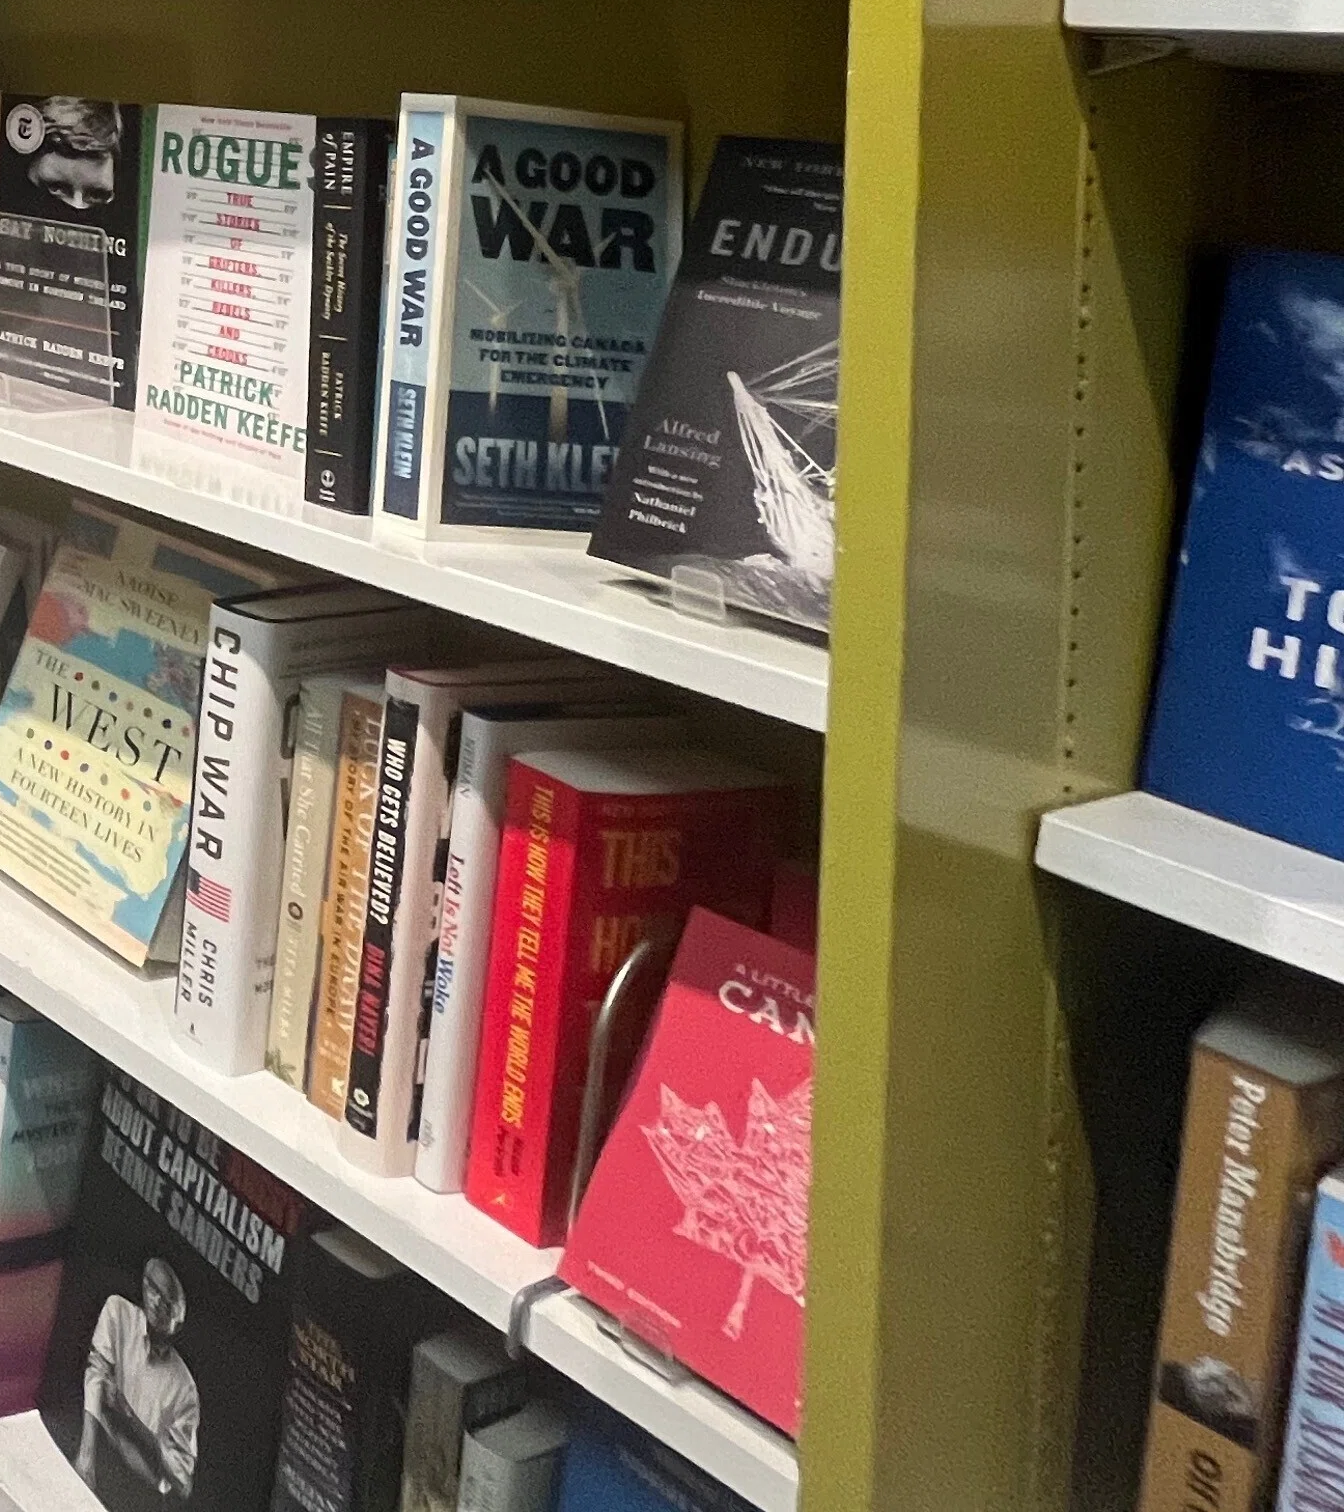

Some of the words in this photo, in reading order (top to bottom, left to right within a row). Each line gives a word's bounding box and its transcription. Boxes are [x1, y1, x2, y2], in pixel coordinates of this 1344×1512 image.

[473, 144, 501, 187] A
[515, 148, 656, 199] GOOD
[472, 193, 658, 273] WAR
[146, 384, 228, 430] RADDEN
[236, 412, 306, 453] KEEFE
[178, 360, 275, 406] PATRICK
[207, 625, 242, 743] CHIP
[45, 683, 183, 782] WEST
[383, 737, 406, 782] WHO
[195, 754, 231, 863] WAR
[377, 784, 401, 830] GETS
[366, 832, 395, 926] BELIEVED?
[179, 921, 198, 1003] MILLER
[198, 940, 218, 1008] CHRIS
[1224, 1074, 1265, 1156] Peter
[1197, 1160, 1261, 1337] Mansbridge
